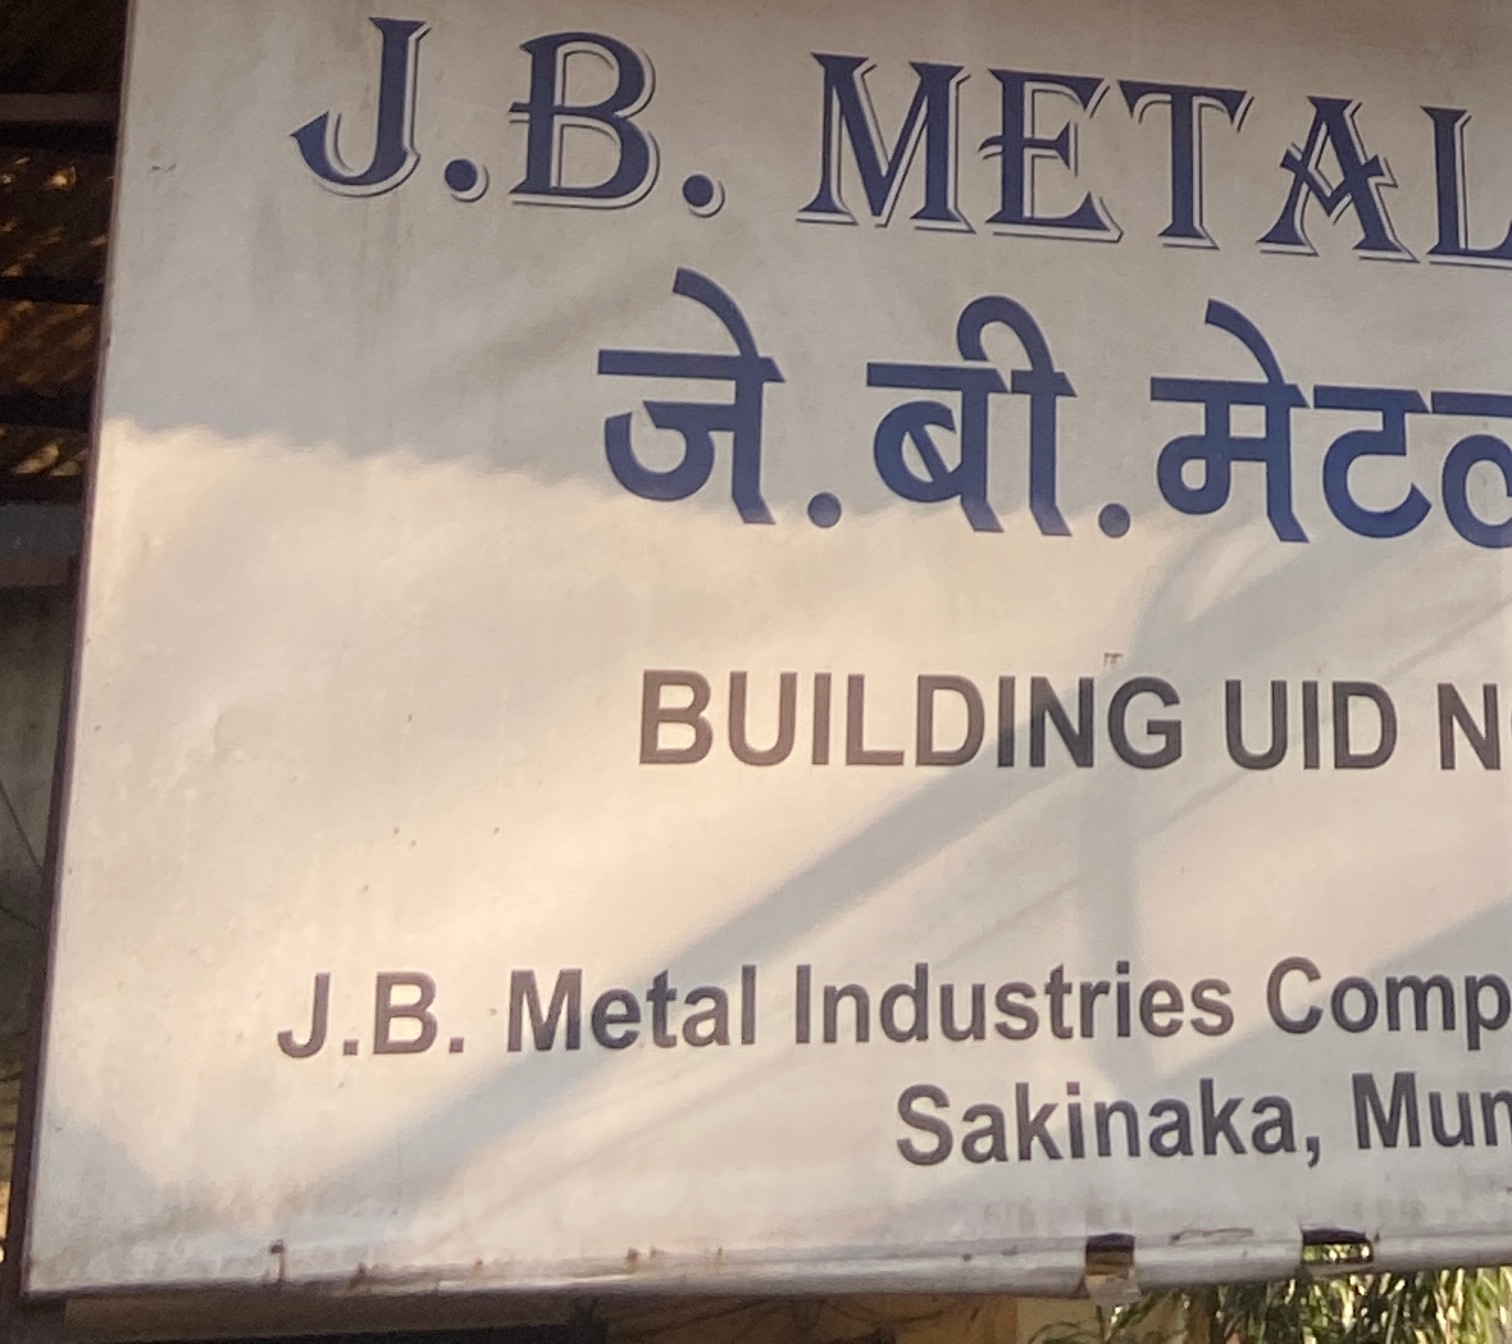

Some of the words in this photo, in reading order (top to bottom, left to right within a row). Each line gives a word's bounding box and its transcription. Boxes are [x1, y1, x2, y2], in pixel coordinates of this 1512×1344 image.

[290, 16, 725, 219] J.B.
[638, 668, 1185, 771] BUILDING
[1223, 678, 1399, 772] UID
[276, 970, 467, 1059] J.B.
[505, 965, 758, 1052] Metal
[795, 960, 1235, 1046] Industries
[895, 1076, 1321, 1169] Sakinaka,
